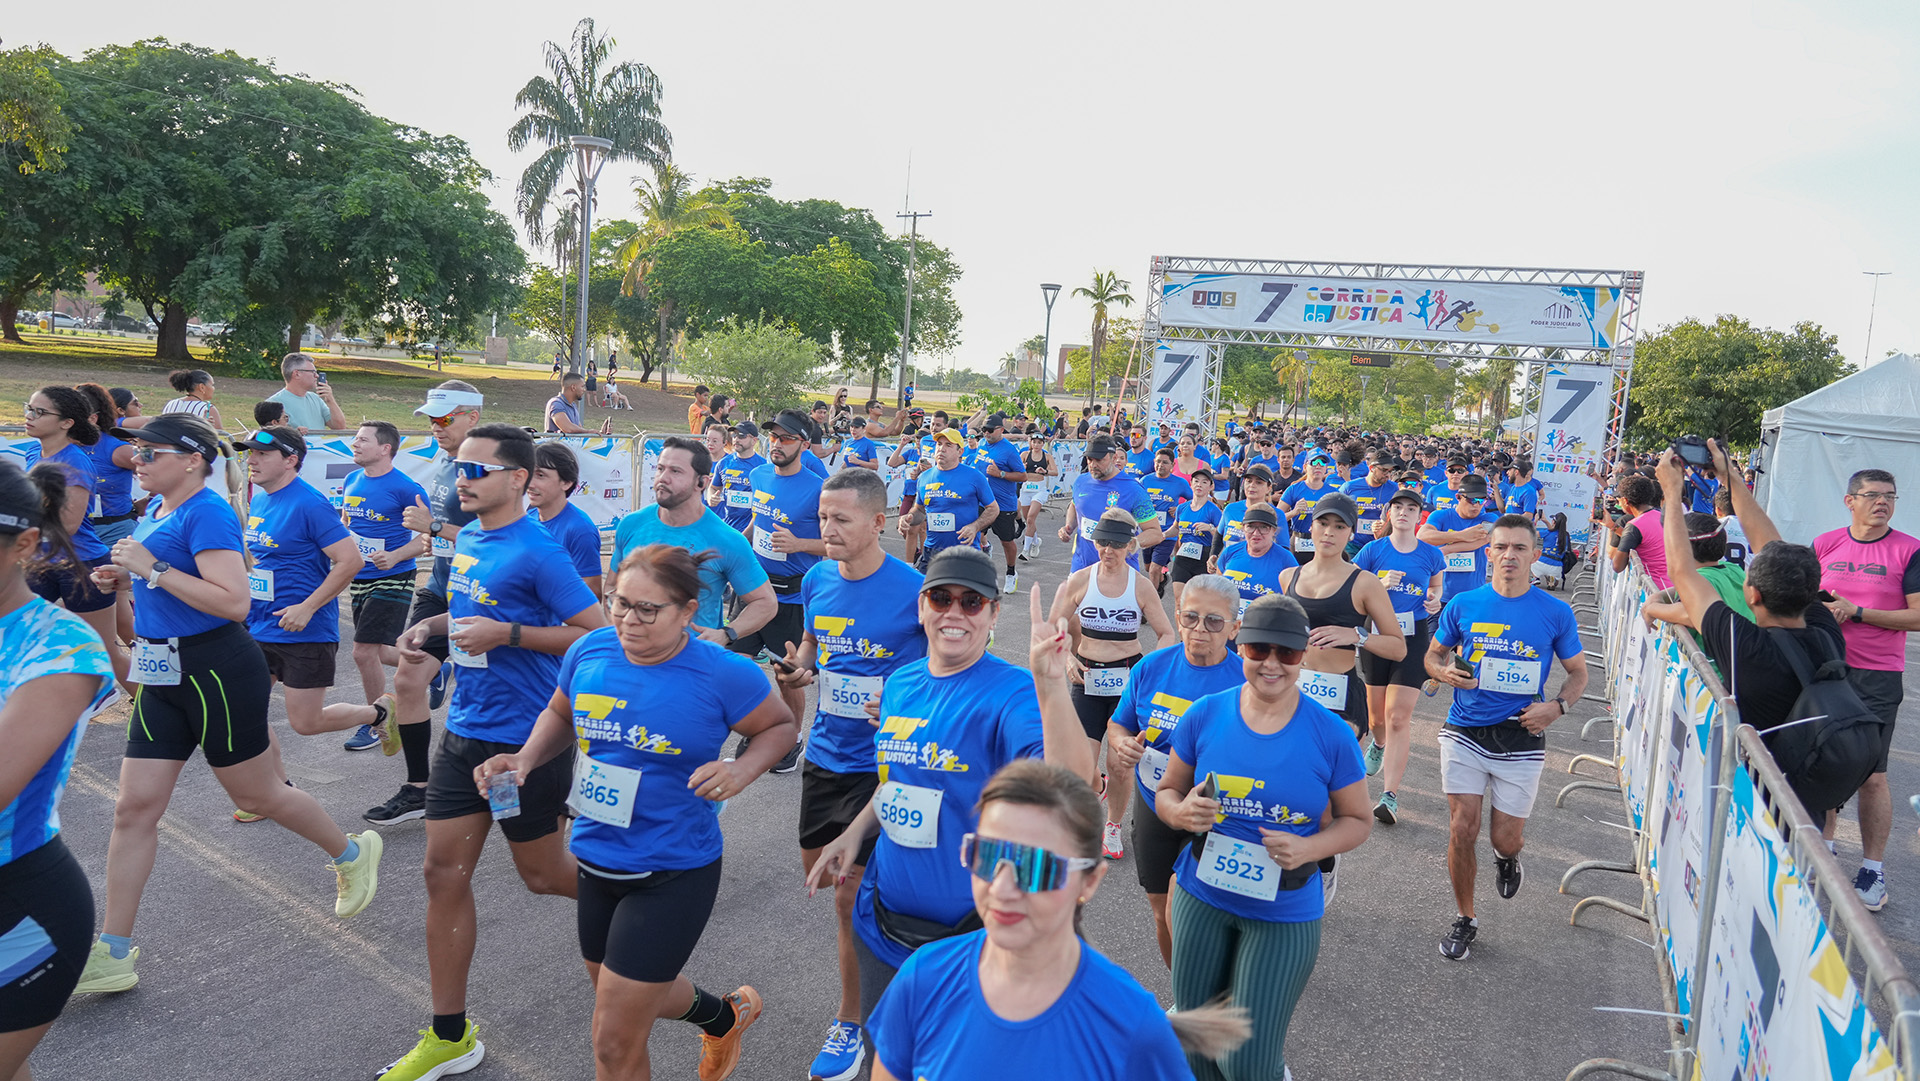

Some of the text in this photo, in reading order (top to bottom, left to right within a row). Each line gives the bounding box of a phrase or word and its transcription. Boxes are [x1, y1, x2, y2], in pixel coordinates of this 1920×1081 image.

[1195, 292, 1234, 305] JUS
[1306, 286, 1405, 305] CORRIDA
[1305, 304, 1404, 324] da JUSTIÇA
[1352, 355, 1372, 365] Bem
[1550, 463, 1589, 475] JUSTIÇ
[605, 489, 624, 498] JUS
[731, 496, 748, 504] 1054
[1450, 558, 1471, 566] 1026
[816, 635, 853, 646] CORRIDA
[1472, 636, 1509, 645] CORRIDA
[825, 644, 855, 654] JUSTIÇA
[1482, 644, 1509, 652] JUSTIÇA
[138, 657, 169, 673] 5506
[1094, 677, 1124, 688] 5438
[1496, 671, 1530, 684] 5194
[1302, 682, 1337, 698] 5036
[831, 689, 871, 705] 5503
[1150, 709, 1180, 723] CORRI
[575, 716, 622, 732] CORRIDA
[1158, 720, 1178, 730] JUST
[583, 728, 622, 742] JUSTIÇA
[877, 740, 918, 753] CORRIDA
[882, 751, 918, 765] JUSTIÇA
[579, 777, 620, 806] 5865
[880, 802, 923, 828] 5899
[1213, 854, 1266, 882] 5923
